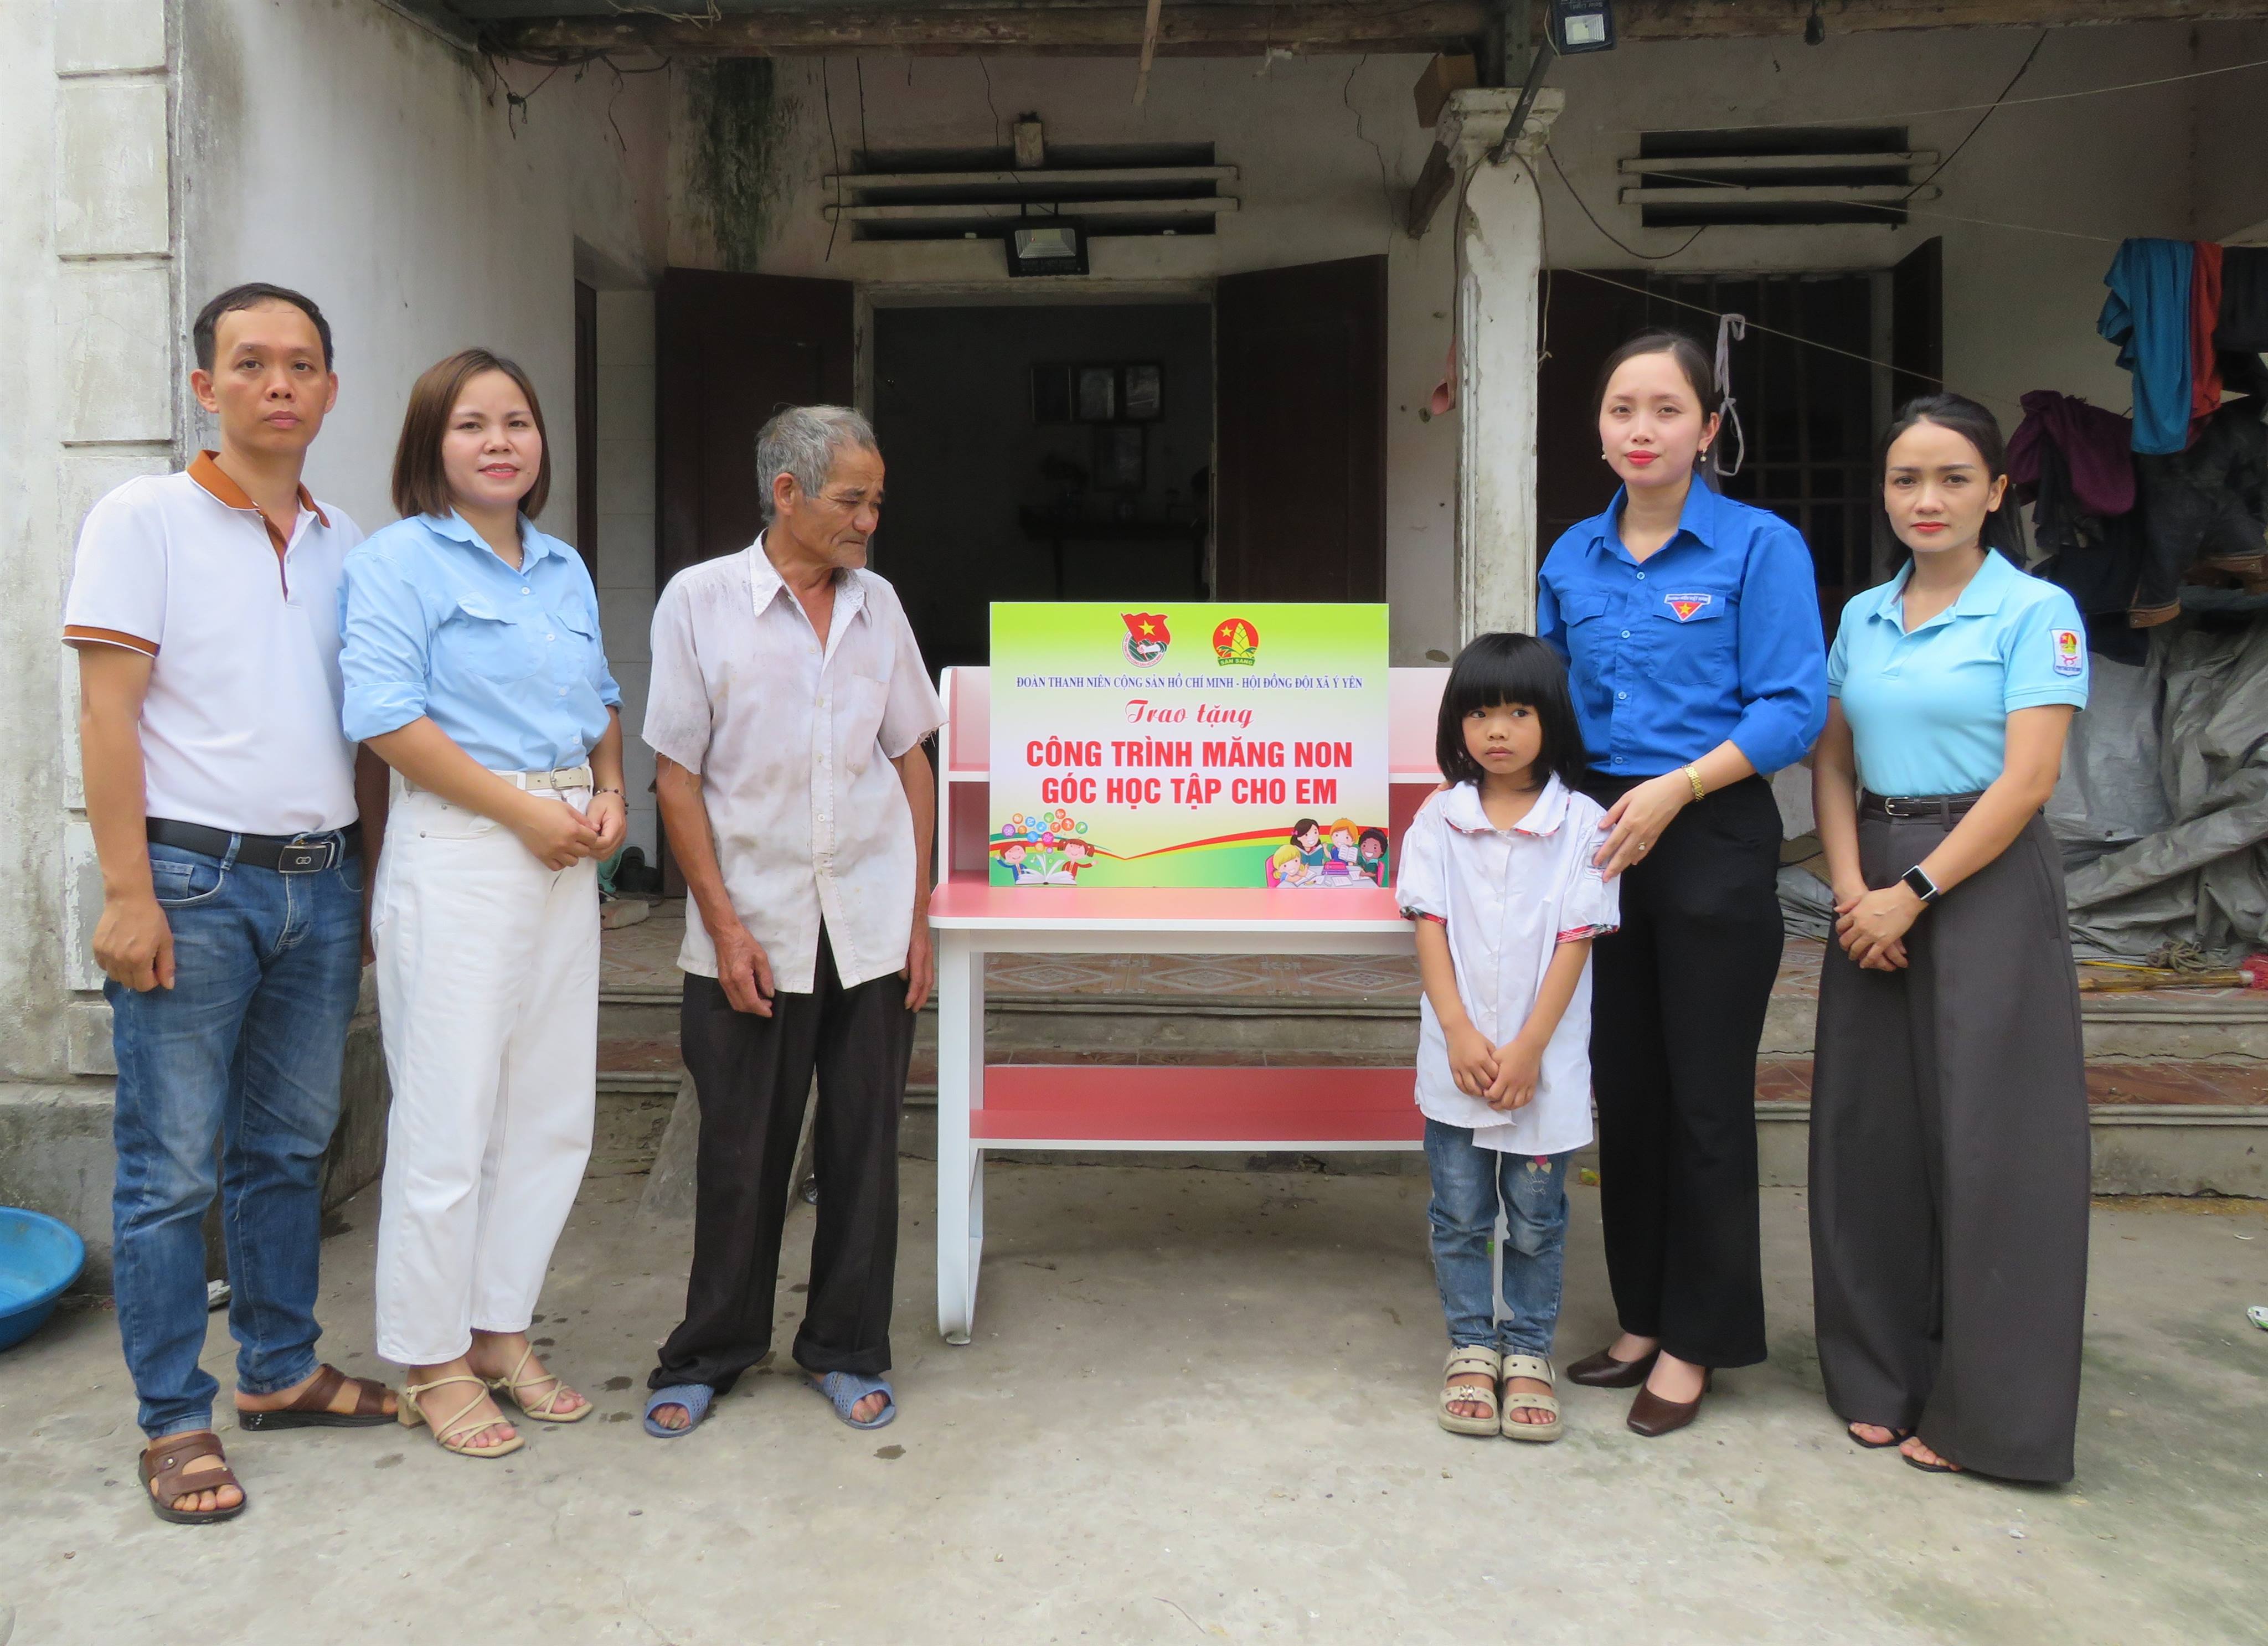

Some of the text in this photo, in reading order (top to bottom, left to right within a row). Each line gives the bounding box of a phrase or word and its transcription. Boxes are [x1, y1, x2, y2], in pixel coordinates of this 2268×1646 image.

[1017, 674, 1045, 688] ĐOÀN
[1048, 677, 1084, 688] THANH
[1086, 674, 1111, 688] NIÊN
[1114, 674, 1143, 690] CỘNG
[1145, 674, 1165, 688] SẢN
[1168, 672, 1183, 688] HỒ
[1185, 674, 1204, 688] CHÍ
[1206, 677, 1234, 688] MINH
[1242, 674, 1261, 690] HỘI
[1263, 673, 1292, 688] ĐỒNG
[1295, 675, 1313, 690] ĐỘI
[1316, 675, 1329, 689] XÃ
[1332, 675, 1339, 689] Ý
[1342, 675, 1363, 689] YÊN
[1125, 699, 1254, 729] Trao tặng
[1027, 735, 1353, 768] CÔNG TRÌNH MĂNG NON
[1042, 772, 1337, 810] GÓC HỌC TẬP CHO EM
